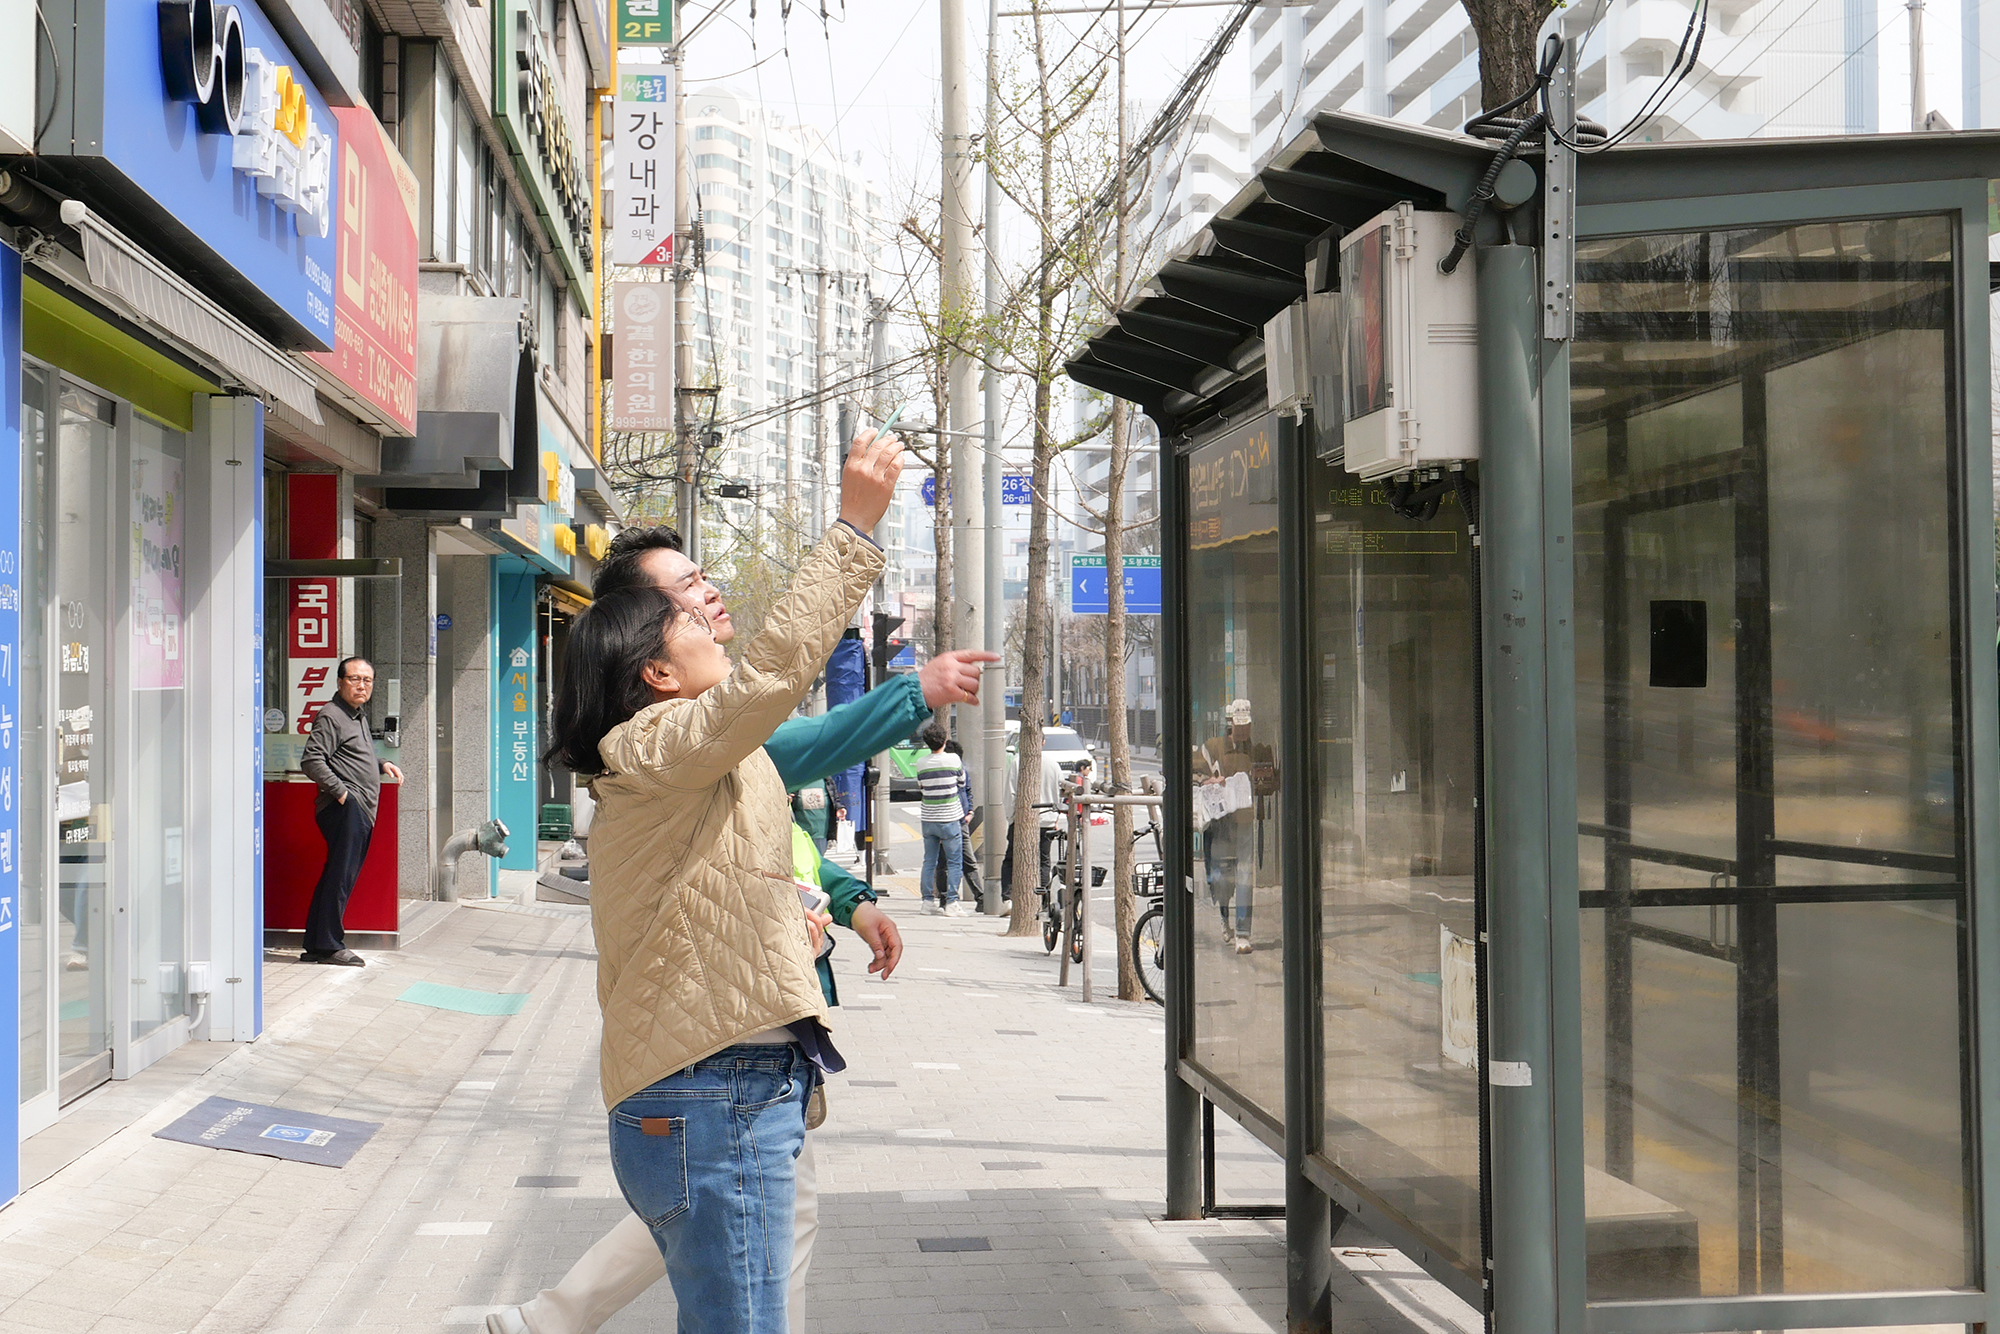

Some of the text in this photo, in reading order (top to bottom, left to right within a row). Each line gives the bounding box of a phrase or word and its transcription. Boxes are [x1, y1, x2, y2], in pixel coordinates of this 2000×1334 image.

[624, 21, 662, 38] 2F
[623, 79, 665, 101] 쌍문동
[628, 111, 664, 225] 강내과
[631, 228, 656, 241] 의원
[655, 246, 672, 262] 3F
[615, 416, 668, 429] 999-8181
[1081, 558, 1103, 566] 방학로
[511, 672, 529, 782] 서울 부동산
